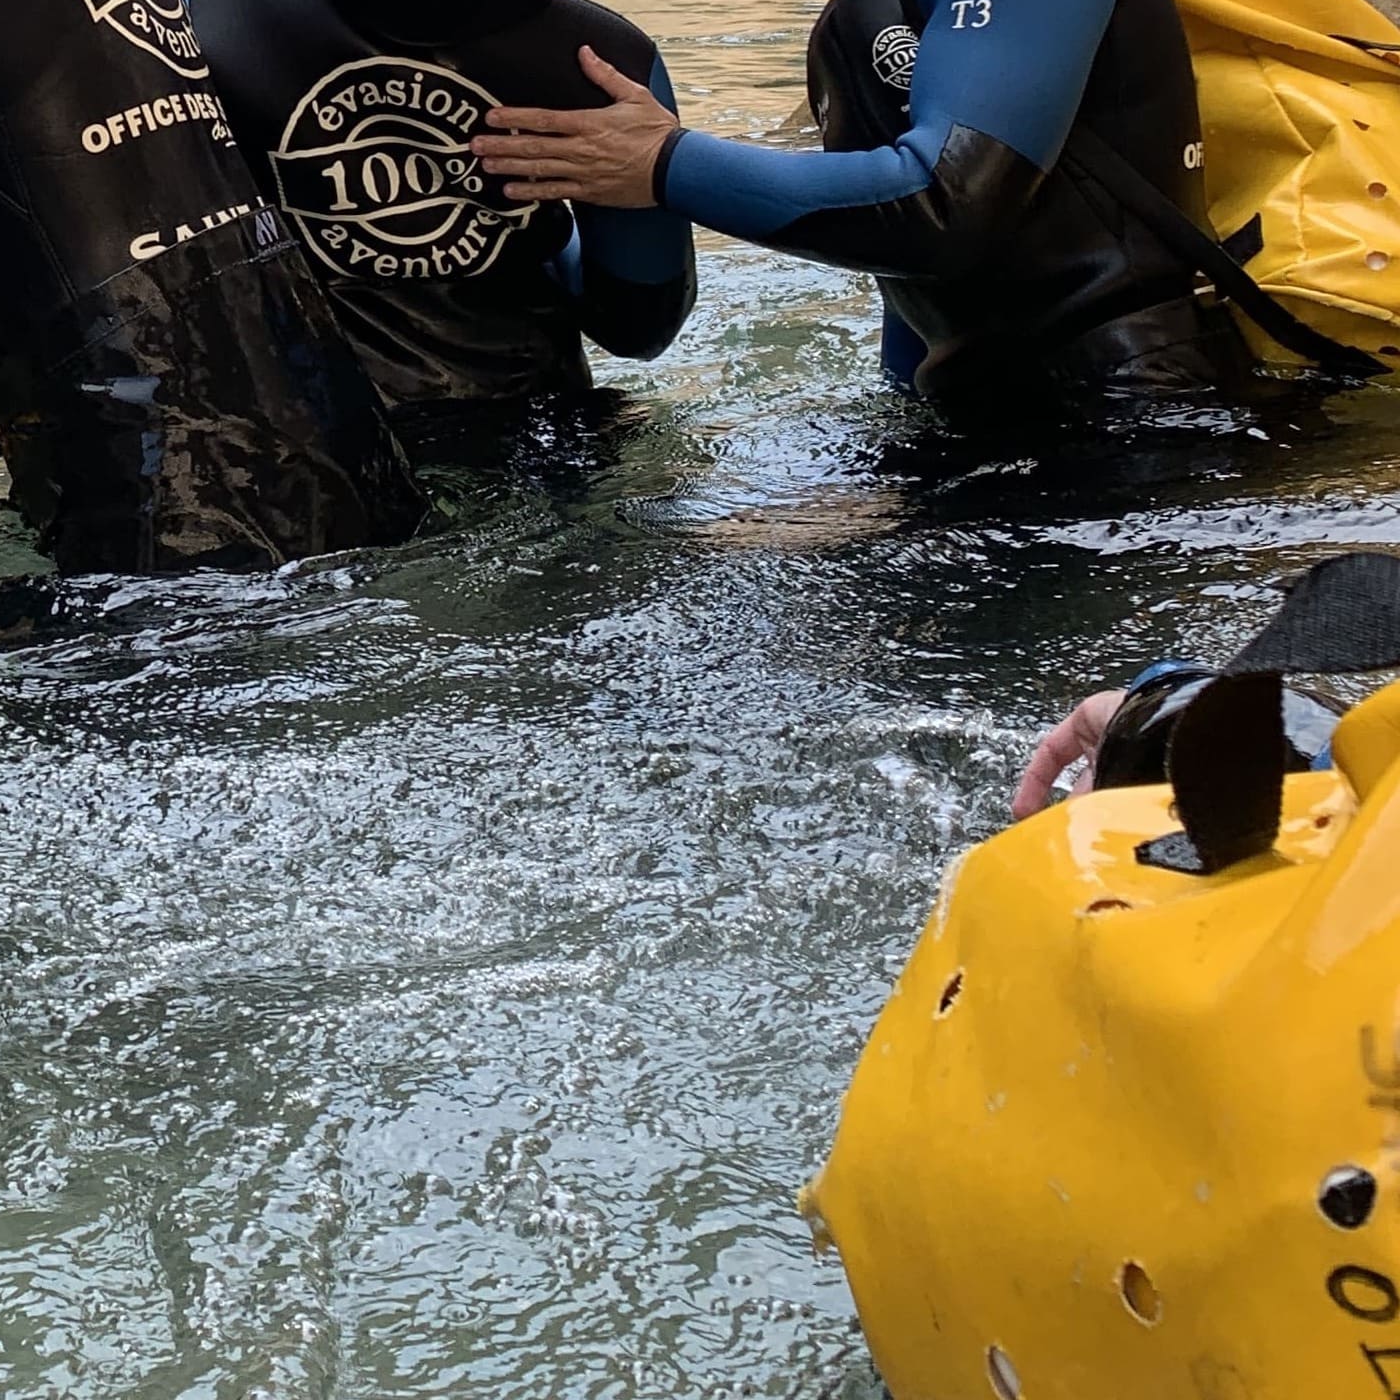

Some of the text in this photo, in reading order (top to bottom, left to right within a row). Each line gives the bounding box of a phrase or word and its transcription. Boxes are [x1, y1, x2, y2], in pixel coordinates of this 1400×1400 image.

[81, 94, 187, 154] OFFICE
[183, 93, 219, 120] DES
[311, 72, 480, 133] évasion
[322, 152, 483, 211] 100%
[320, 208, 500, 278] aventure
